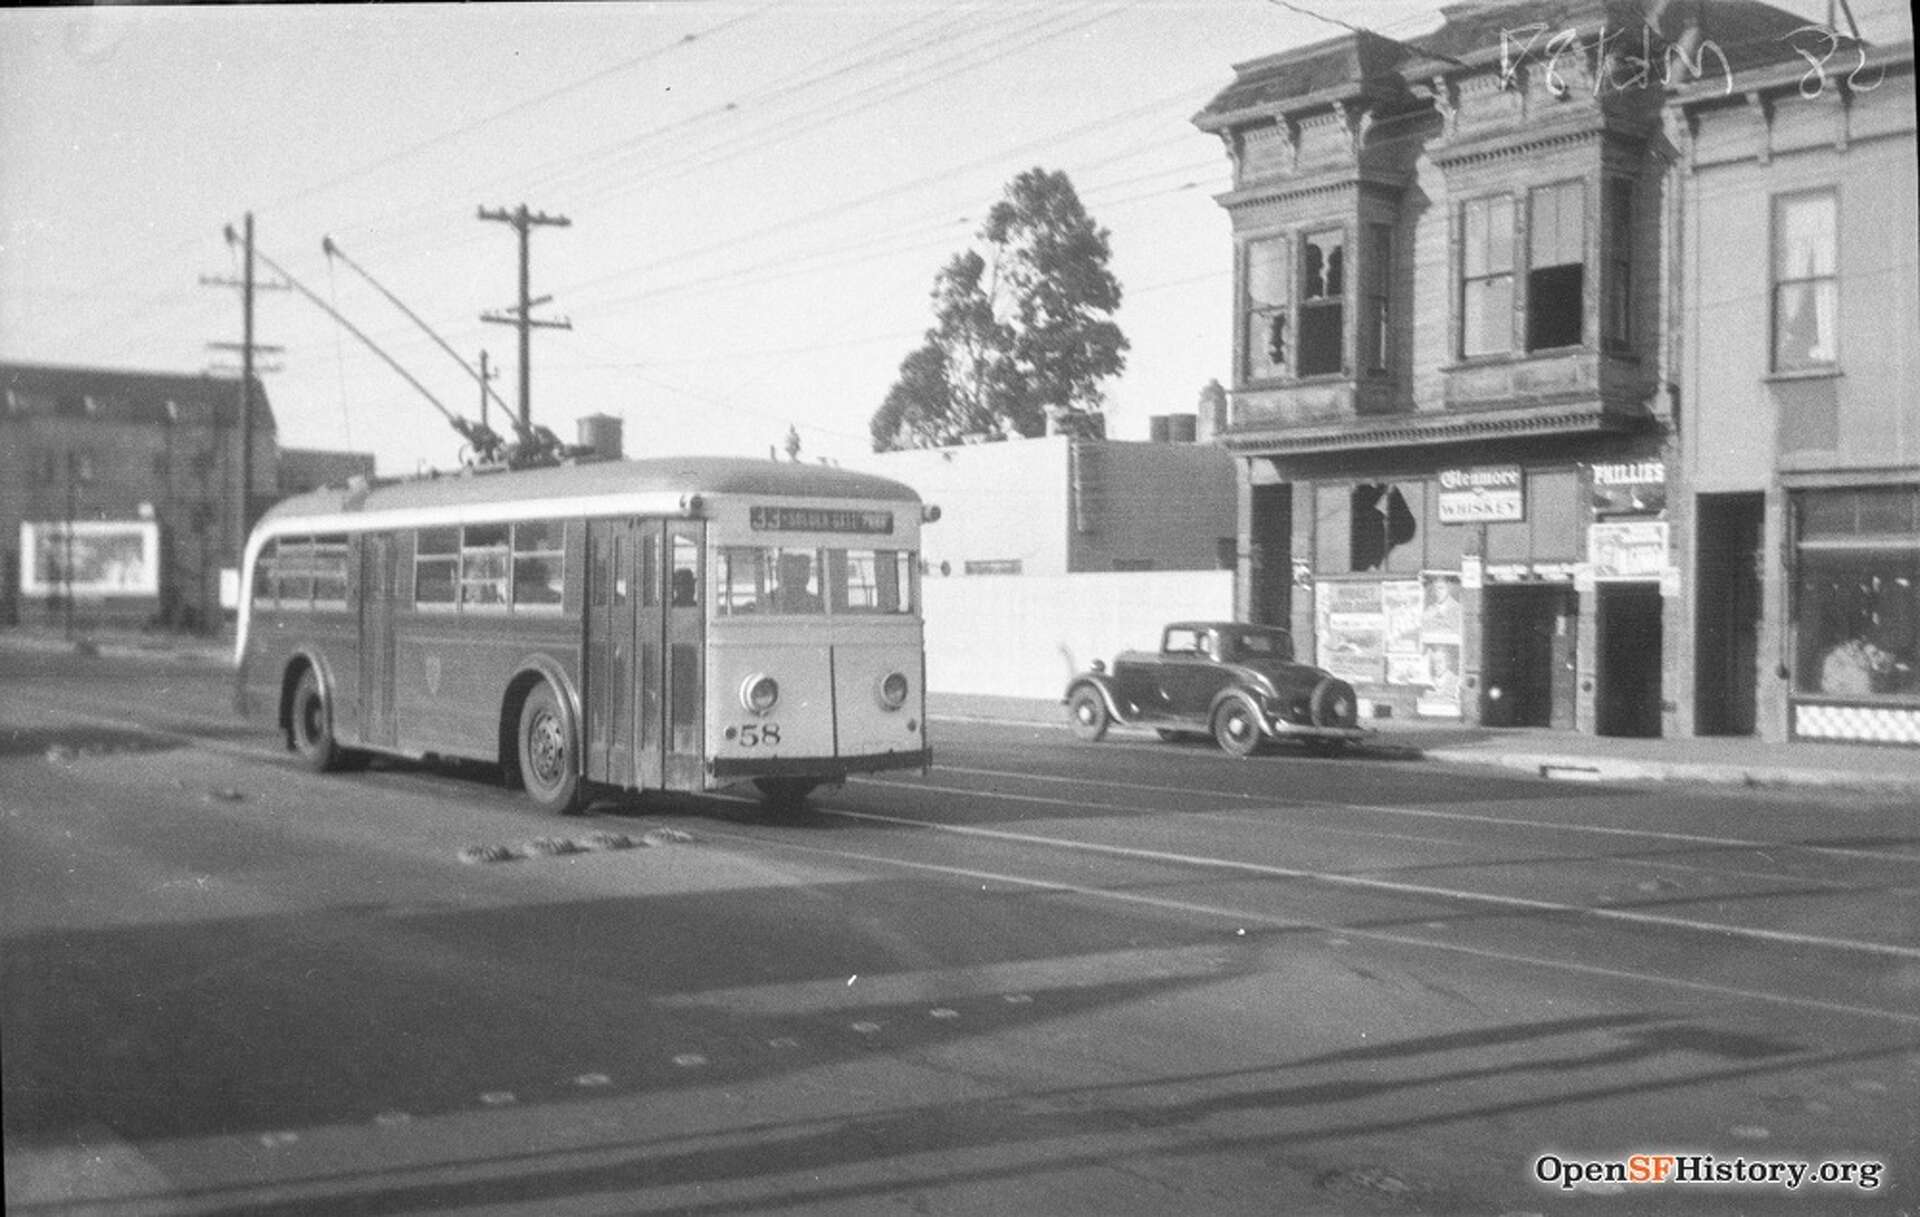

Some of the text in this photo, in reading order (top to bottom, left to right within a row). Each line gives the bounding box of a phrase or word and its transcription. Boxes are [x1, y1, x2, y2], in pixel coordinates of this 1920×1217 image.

[1440, 469, 1519, 489] Glenmore
[1591, 462, 1665, 485] PHILLIES
[1440, 501, 1517, 516] WHISKEY
[738, 723, 781, 747] 58
